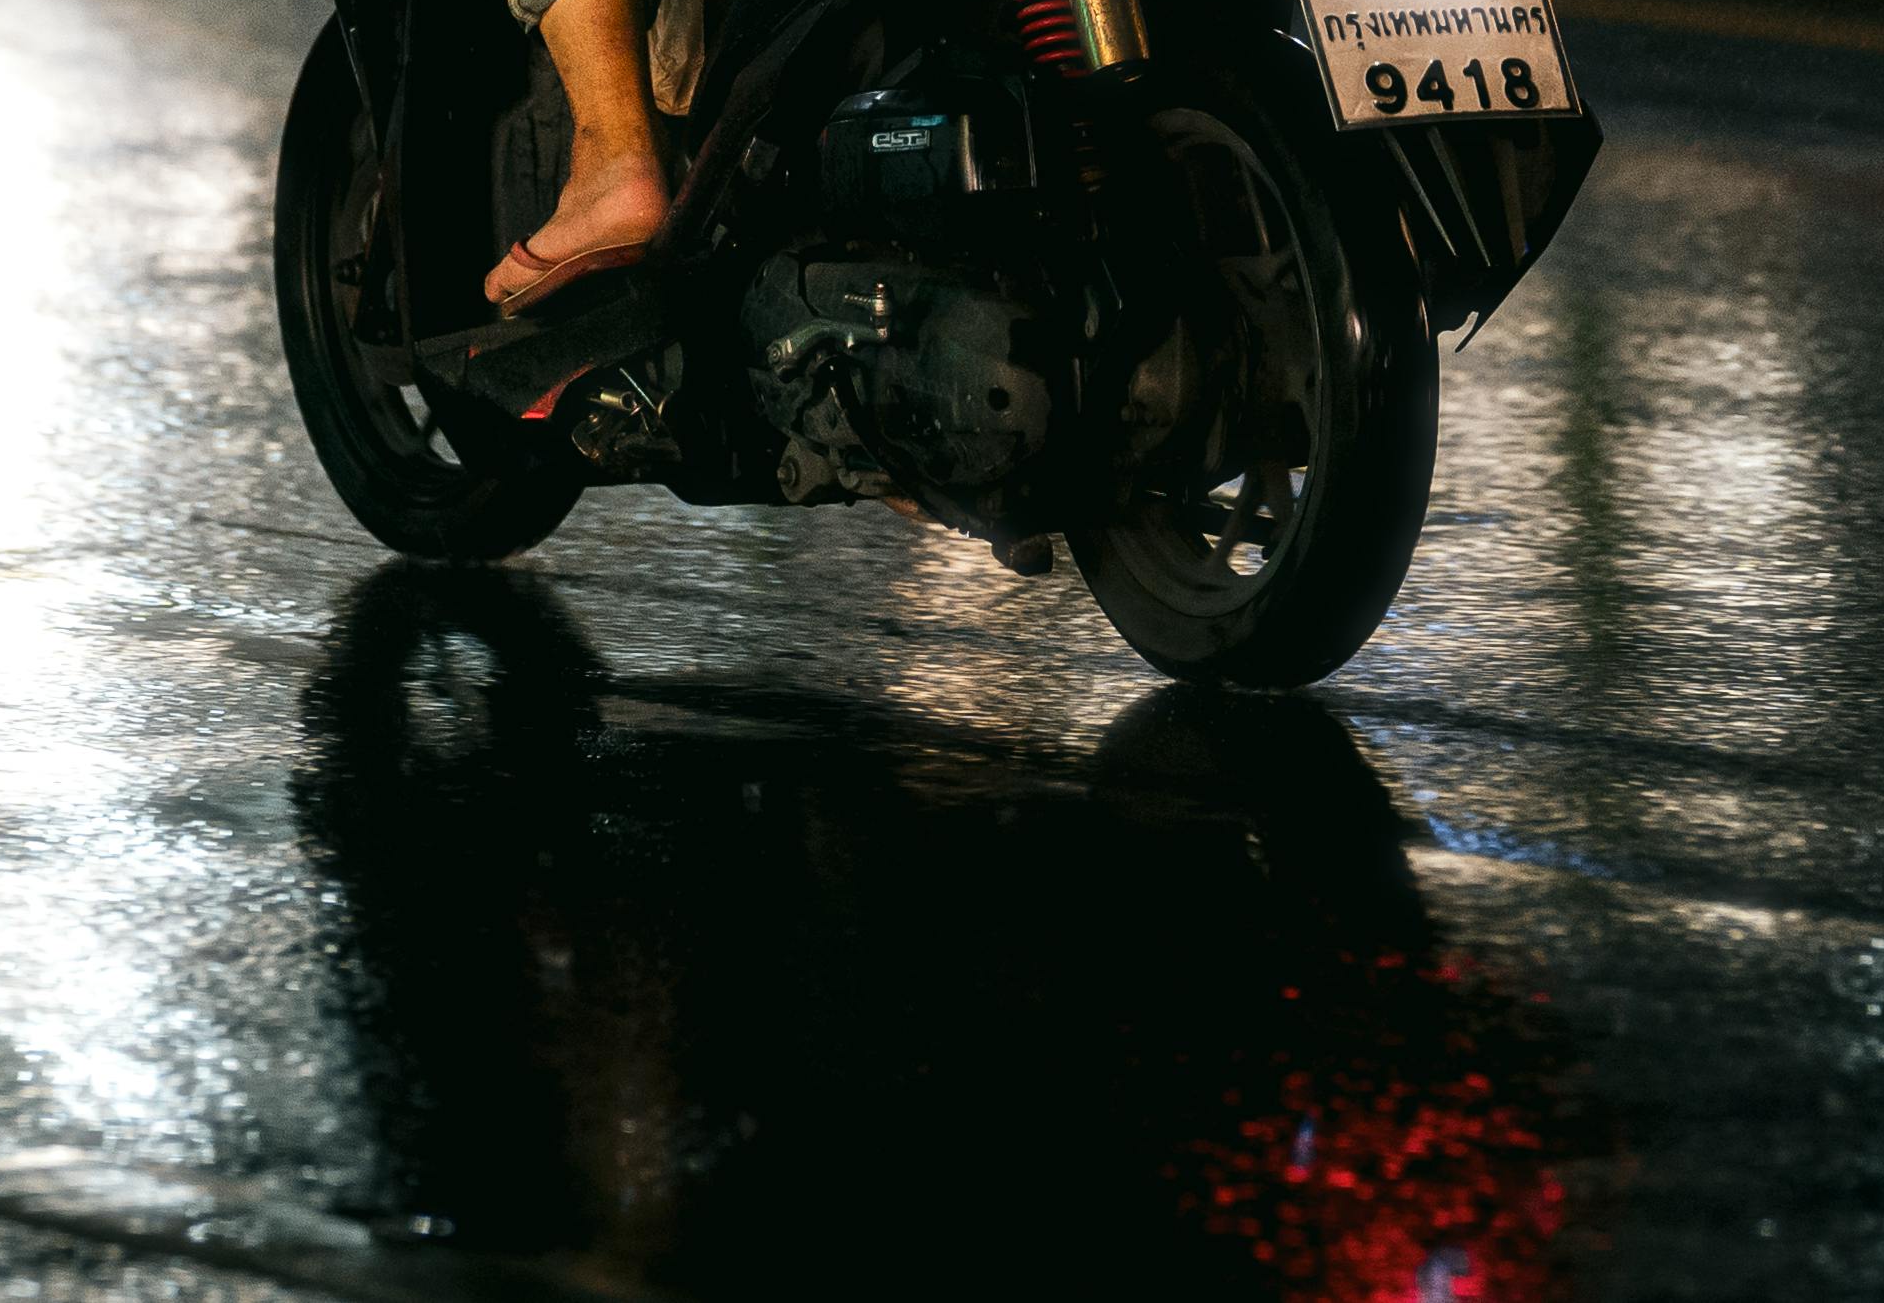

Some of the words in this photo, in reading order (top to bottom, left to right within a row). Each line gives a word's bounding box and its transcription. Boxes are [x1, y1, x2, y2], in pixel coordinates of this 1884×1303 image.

[1323, 5, 1547, 50] กรุงเทพมหานคร
[1365, 58, 1540, 114] 9418
